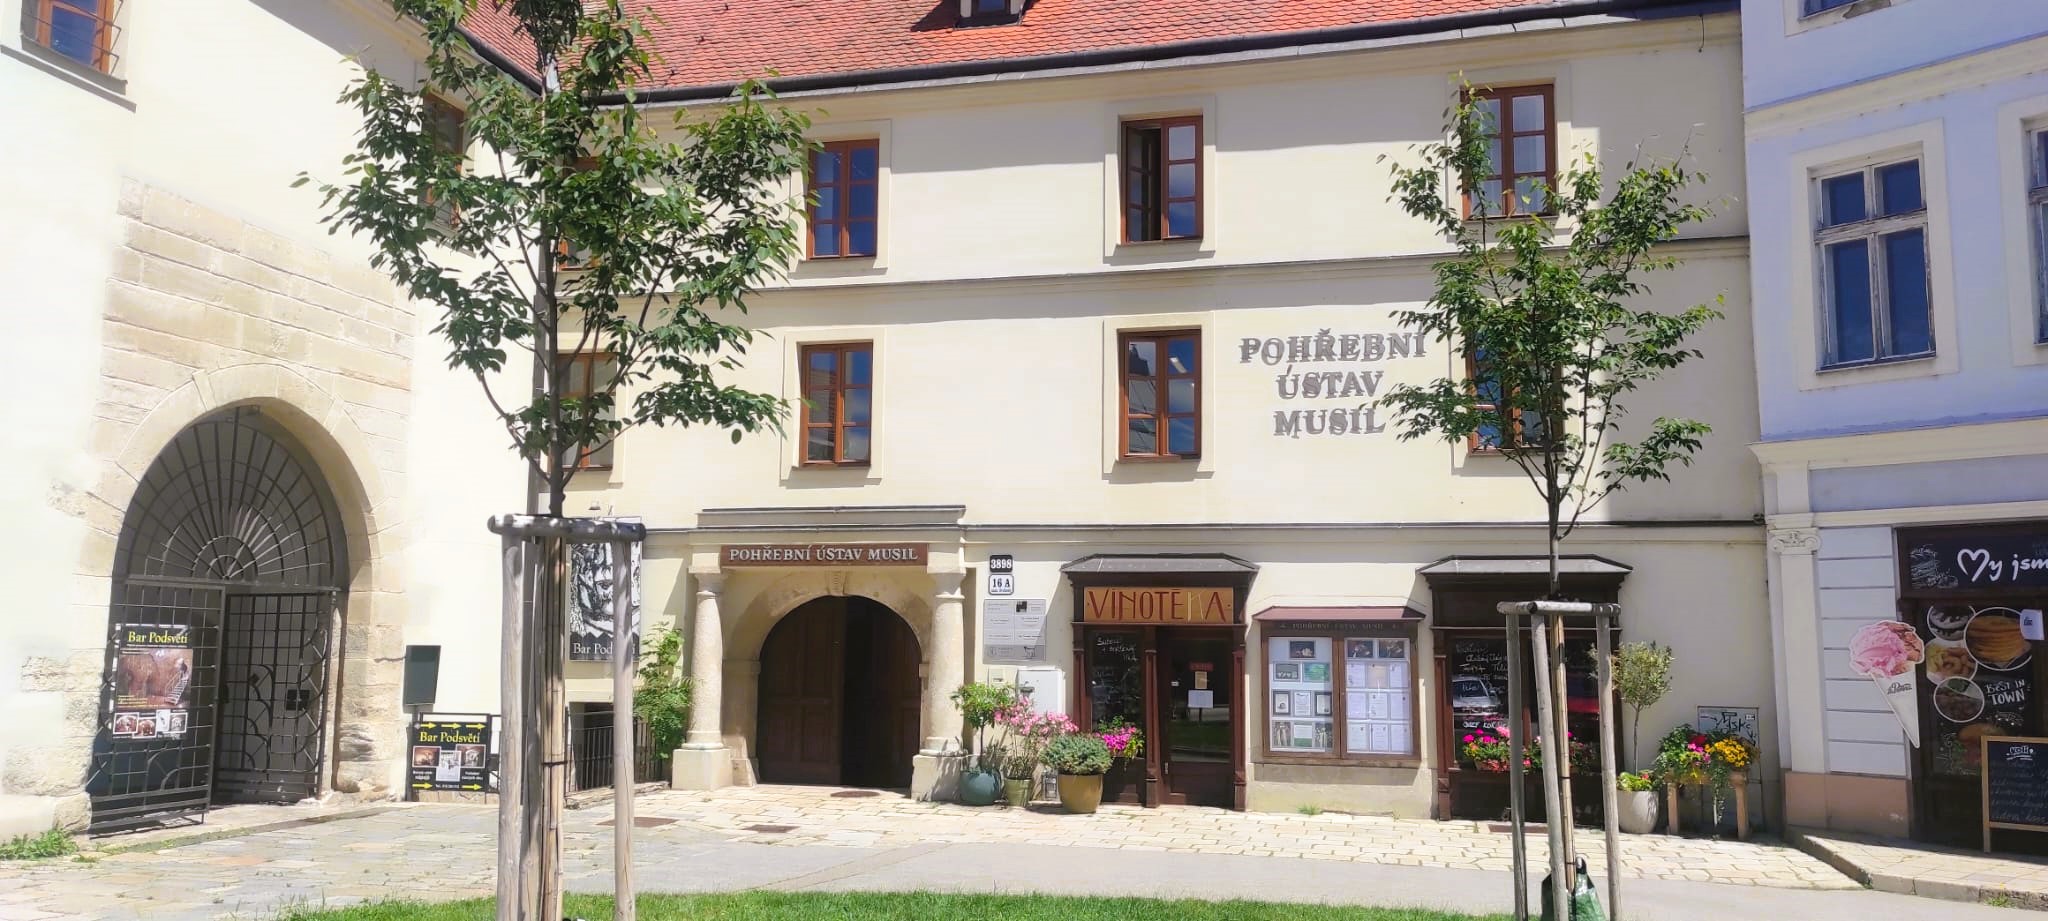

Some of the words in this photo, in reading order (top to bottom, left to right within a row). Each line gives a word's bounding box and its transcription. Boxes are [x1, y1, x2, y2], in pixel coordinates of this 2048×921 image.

[1239, 325, 1427, 365] POHŘEBNÍ
[1275, 364, 1384, 399] ÚSTAV
[1273, 407, 1386, 439] MUSIL
[729, 545, 812, 561] POHŘEBNÍ
[816, 544, 863, 561] ÚSTAV
[868, 548, 919, 561] MUSIL
[991, 559, 1012, 569] 3898
[993, 578, 1002, 588] 16
[1004, 578, 1010, 588] A
[128, 631, 147, 643] Bar
[573, 643, 591, 654] Bar
[1988, 688, 2025, 705] TOWN
[419, 732, 437, 743] Bar
[440, 730, 481, 743] Podsvětí
